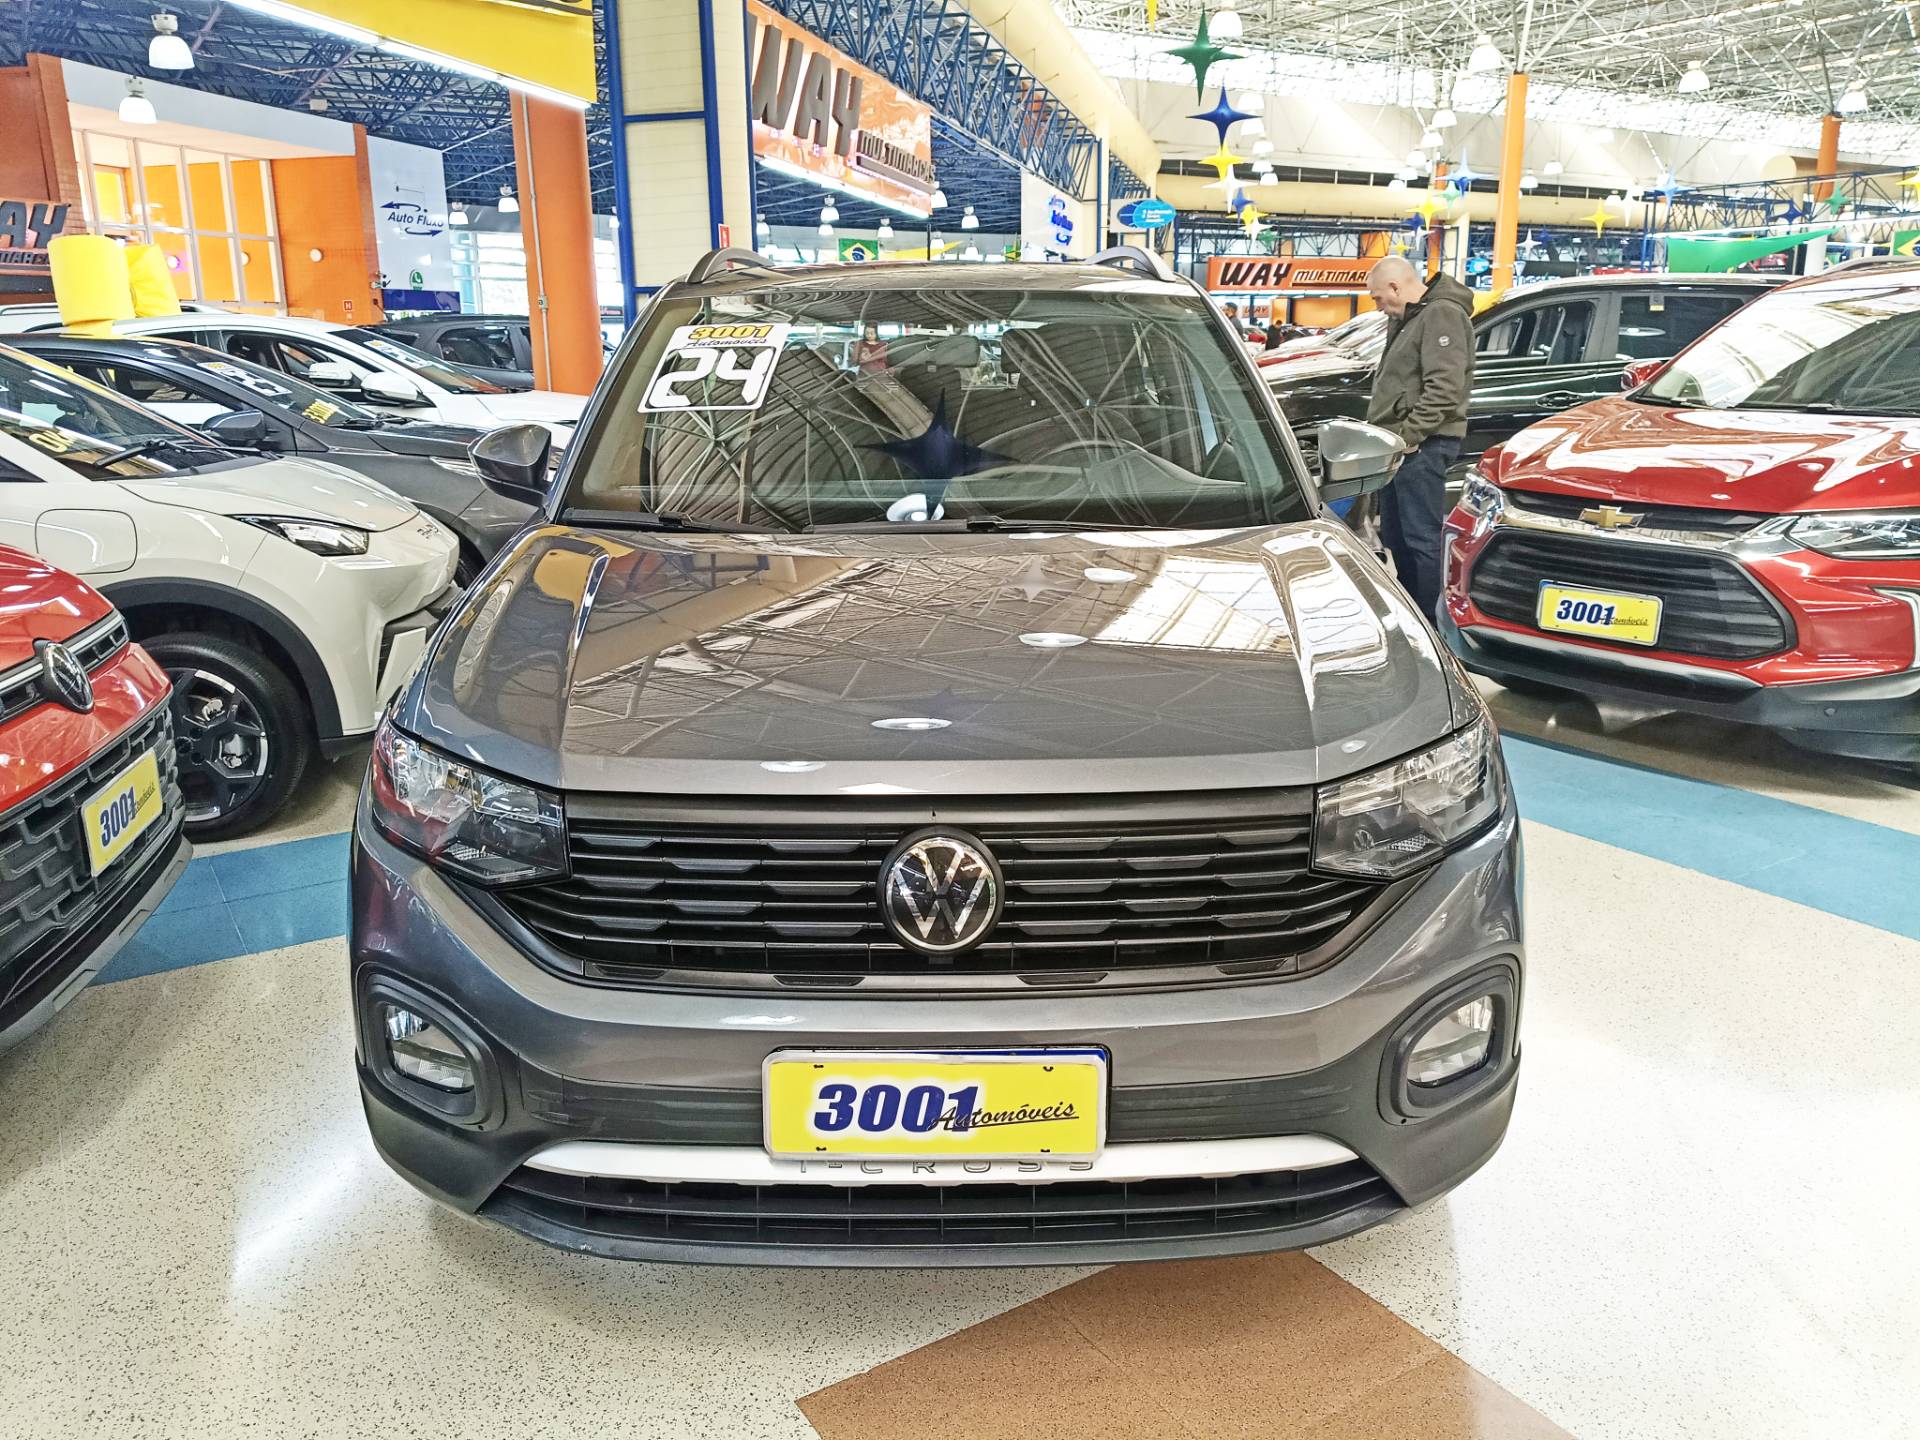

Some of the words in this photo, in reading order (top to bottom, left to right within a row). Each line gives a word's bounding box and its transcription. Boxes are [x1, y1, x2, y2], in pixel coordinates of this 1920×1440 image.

[747, 13, 863, 156] WAY
[388, 211, 414, 225] Auto
[1219, 262, 1293, 287] WAY
[1294, 270, 1368, 282] MULTIMAR
[688, 325, 774, 340] 3001
[649, 347, 775, 408] 24
[1556, 599, 1615, 626] 3001
[100, 786, 136, 847] 3001
[814, 1083, 979, 1133] 3001
[926, 1101, 1077, 1131] Automóveis
